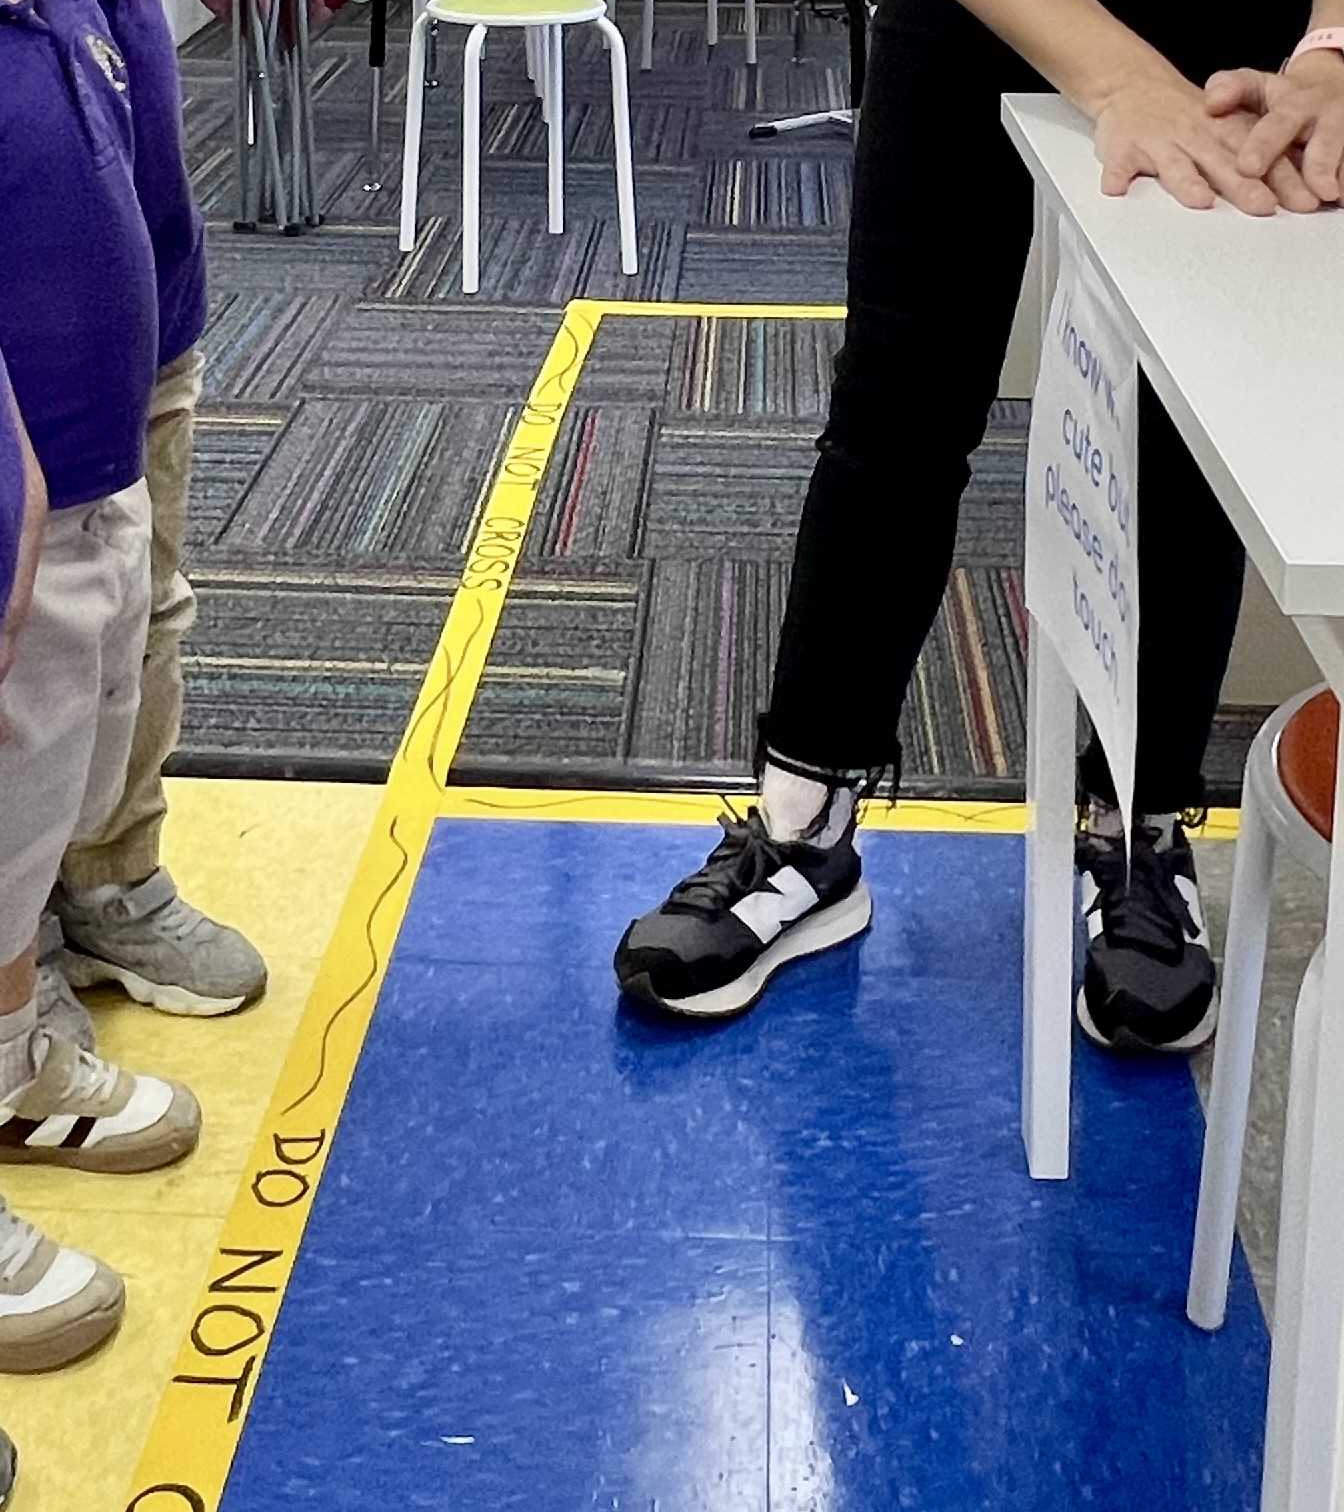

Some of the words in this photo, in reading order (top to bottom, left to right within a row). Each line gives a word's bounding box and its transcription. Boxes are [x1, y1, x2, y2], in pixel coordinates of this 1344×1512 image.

[522, 402, 562, 426] DO
[1062, 408, 1103, 488] cute
[498, 446, 546, 492] NOT
[461, 516, 526, 591] CROSS
[1045, 462, 1104, 574] please
[251, 1128, 326, 1208] DO
[172, 1247, 285, 1424] NOT
